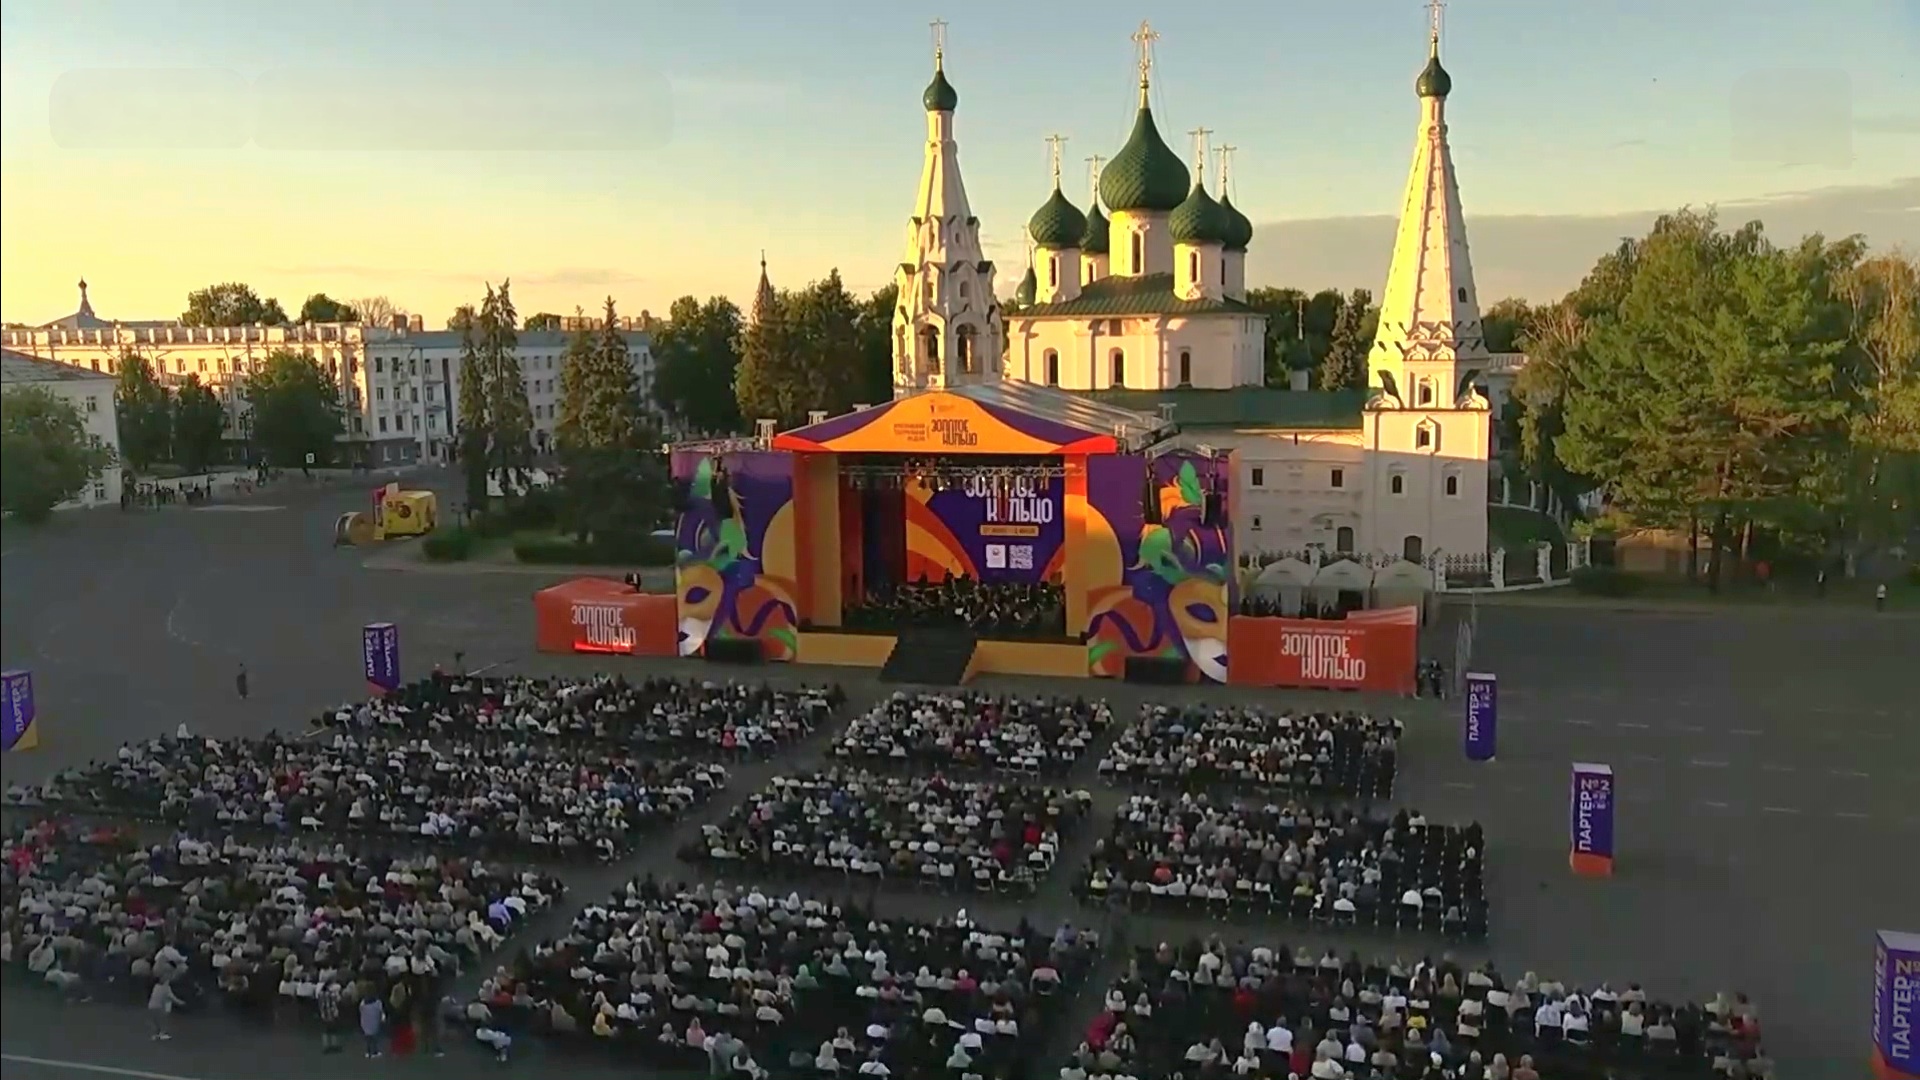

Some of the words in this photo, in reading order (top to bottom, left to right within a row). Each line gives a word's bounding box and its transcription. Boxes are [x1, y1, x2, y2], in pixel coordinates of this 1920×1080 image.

[931, 419, 969, 433] ЗОЛОТОЕ
[943, 432, 978, 446] КОЛЬЦО
[986, 498, 1053, 524] КОЛЬЦО
[571, 604, 624, 627] ЗОЛОТОЕ
[586, 624, 637, 647] КОЛЬЦО
[1281, 633, 1351, 658] ЗОЛОТОЕ
[1301, 656, 1366, 681] КОЛЬЦО
[1468, 693, 1479, 742] ПАРТЕР
[1579, 791, 1592, 852] ПАРТЕР
[1892, 976, 1912, 1059] ПАРТЕР
